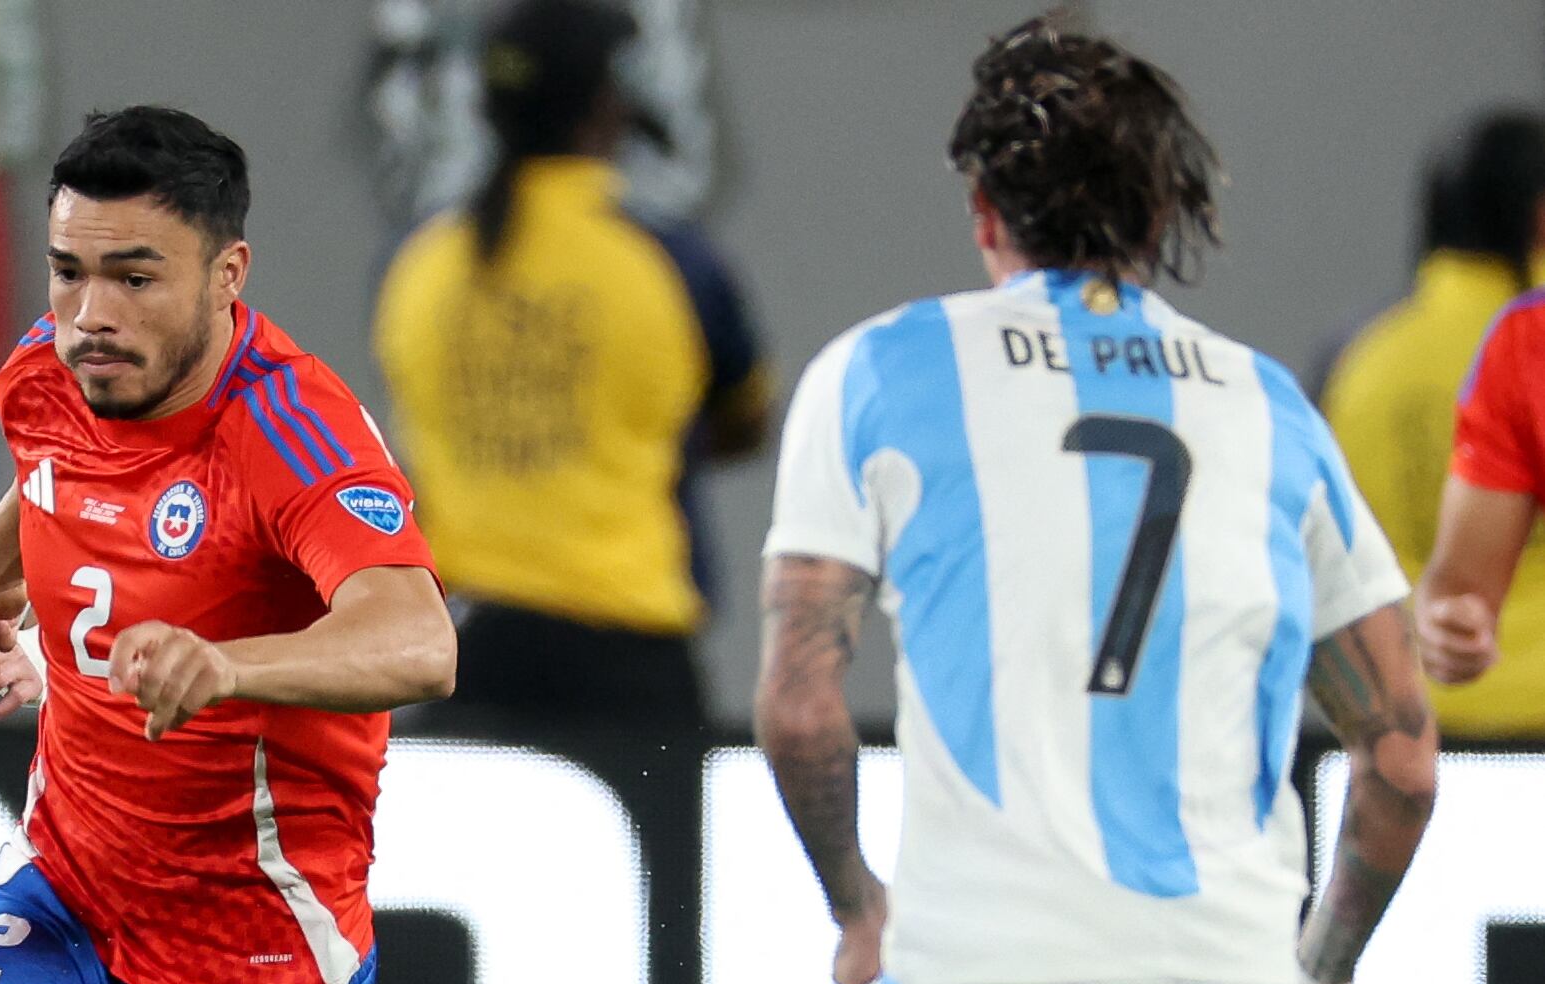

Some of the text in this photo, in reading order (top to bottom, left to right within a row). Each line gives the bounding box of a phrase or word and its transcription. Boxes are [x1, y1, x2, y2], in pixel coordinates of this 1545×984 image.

[1001, 327, 1226, 386] DE PAUL
[1061, 412, 1194, 698] 7
[70, 565, 112, 678] 2
